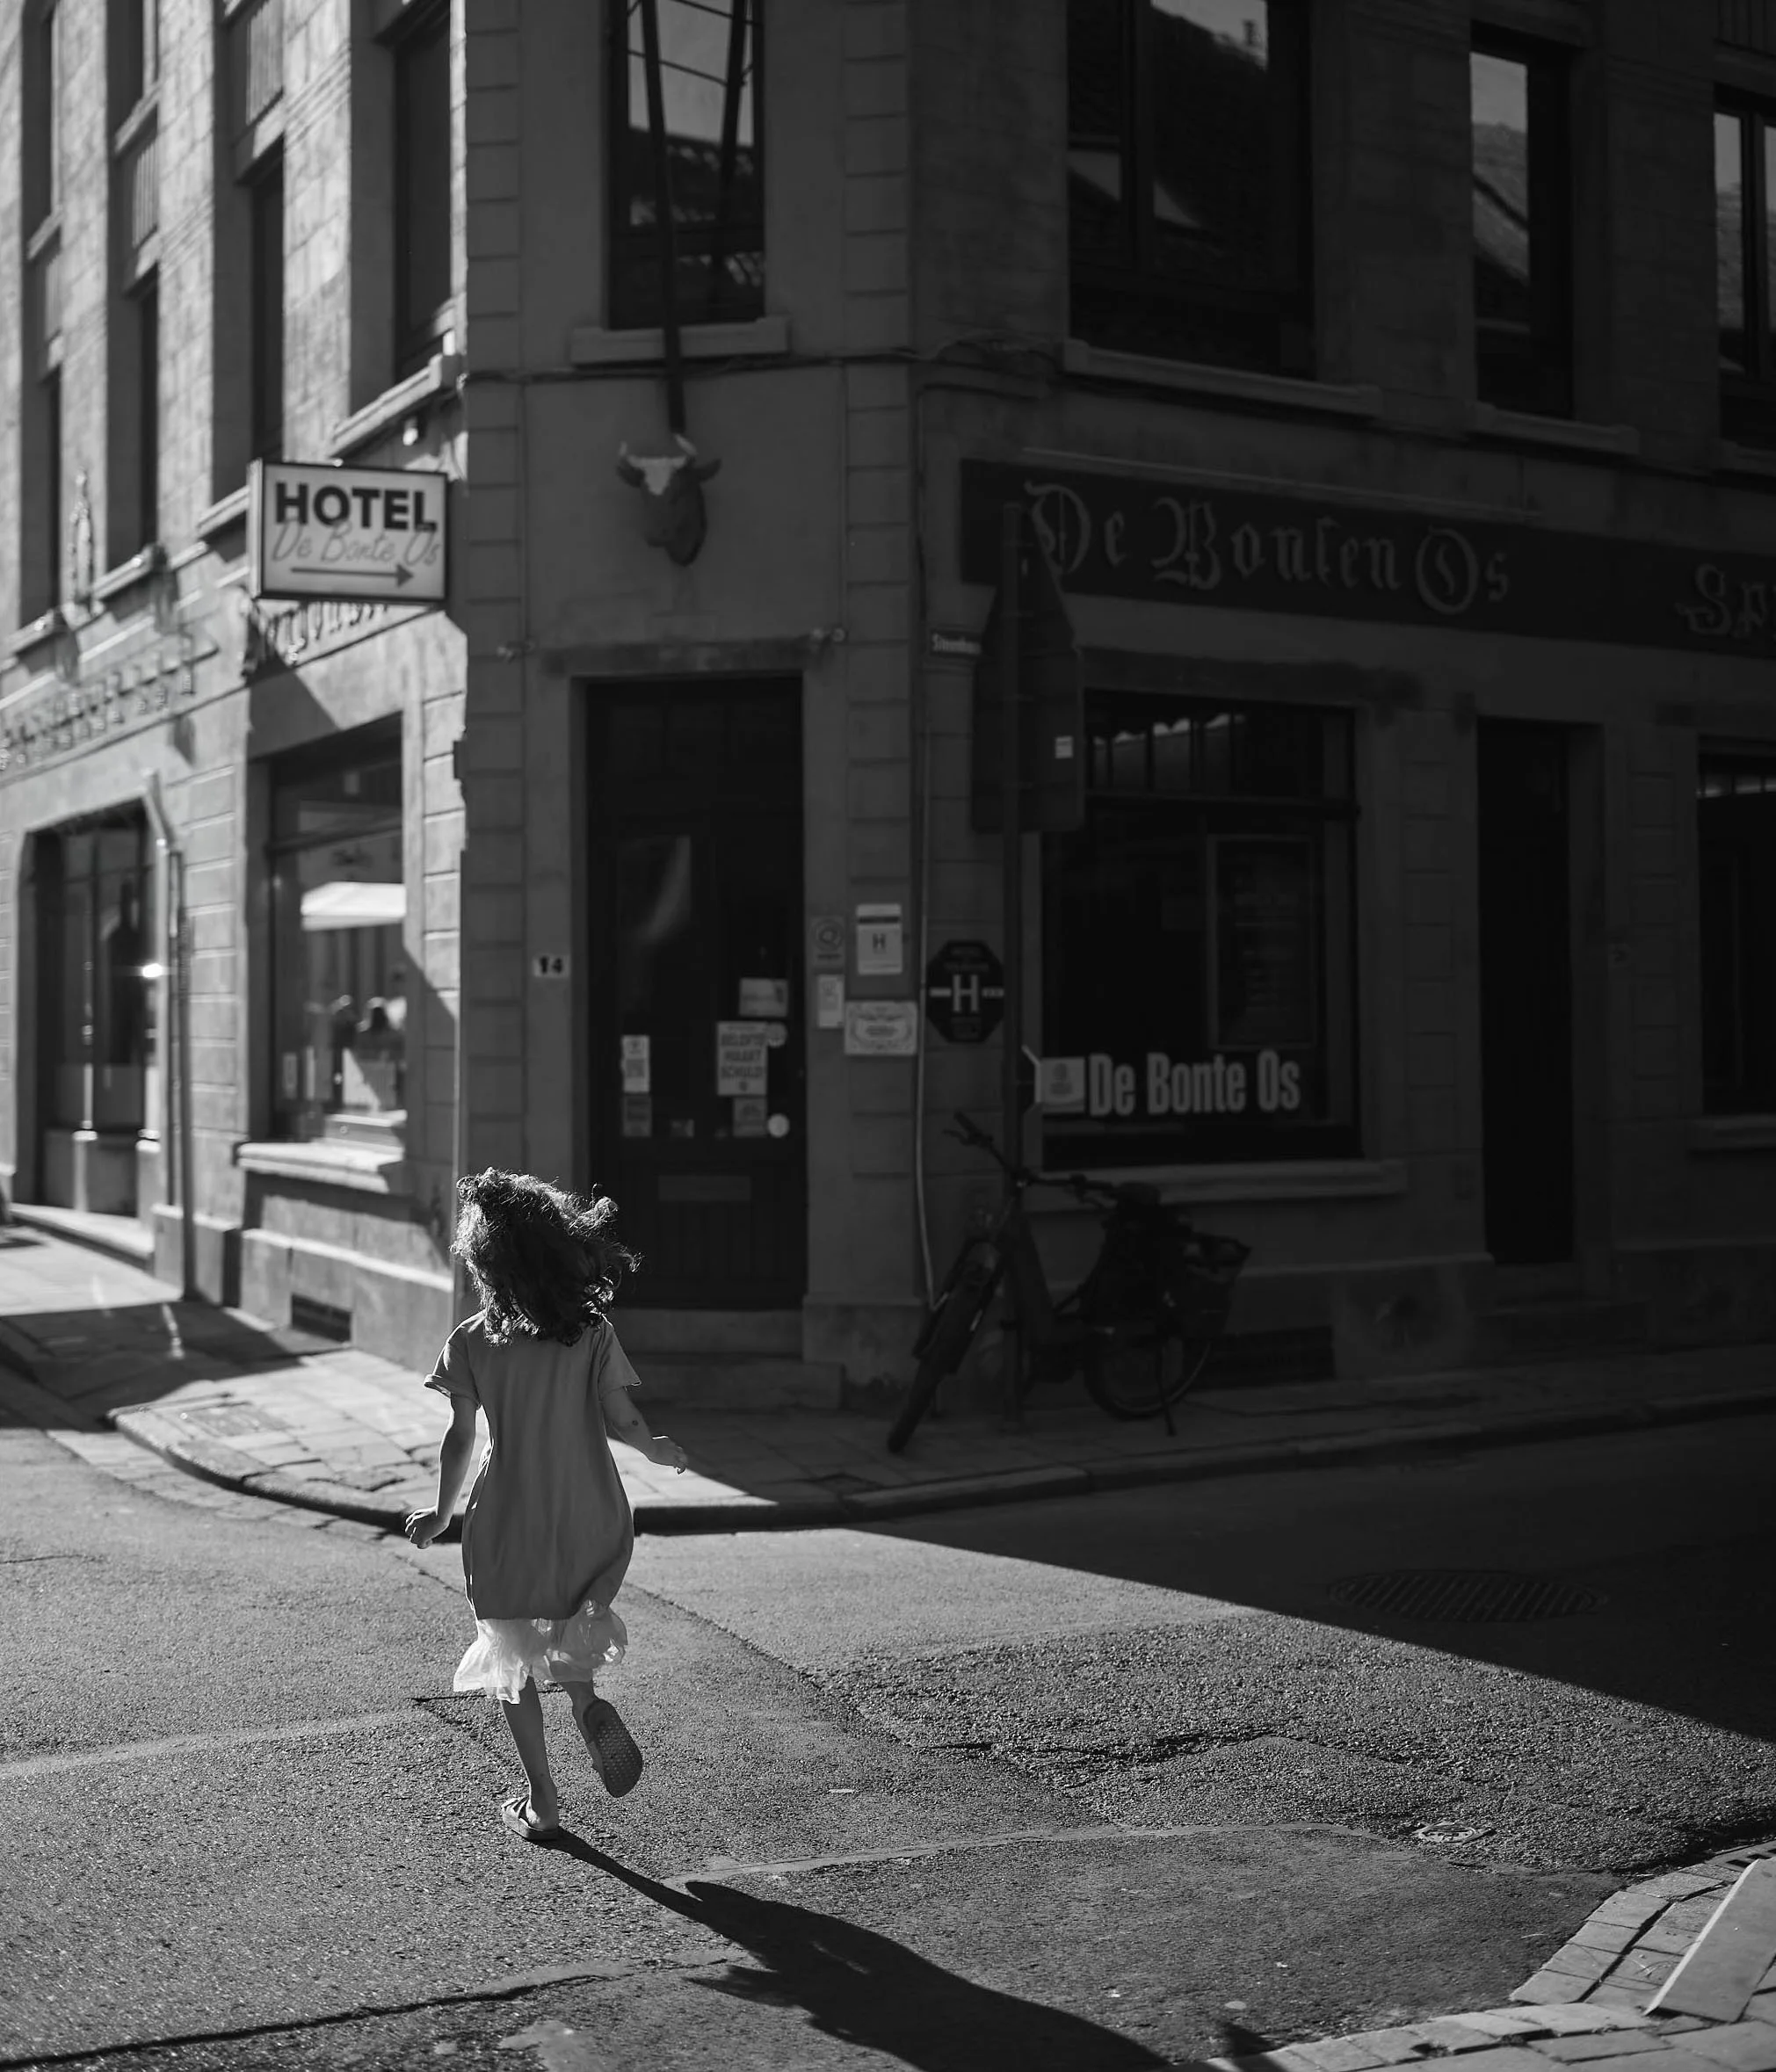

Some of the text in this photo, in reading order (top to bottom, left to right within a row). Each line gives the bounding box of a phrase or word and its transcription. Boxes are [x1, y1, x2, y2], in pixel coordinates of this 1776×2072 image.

[274, 482, 438, 533] HOTEL
[272, 517, 441, 567] De Bonte Os
[1415, 524, 1511, 615] Os
[1673, 562, 1776, 640] Sp
[540, 956, 563, 974] 14
[953, 974, 980, 1014] H
[1088, 1053, 1136, 1118] De
[1146, 1051, 1247, 1116] Bonte
[1257, 1048, 1301, 1112] Os
